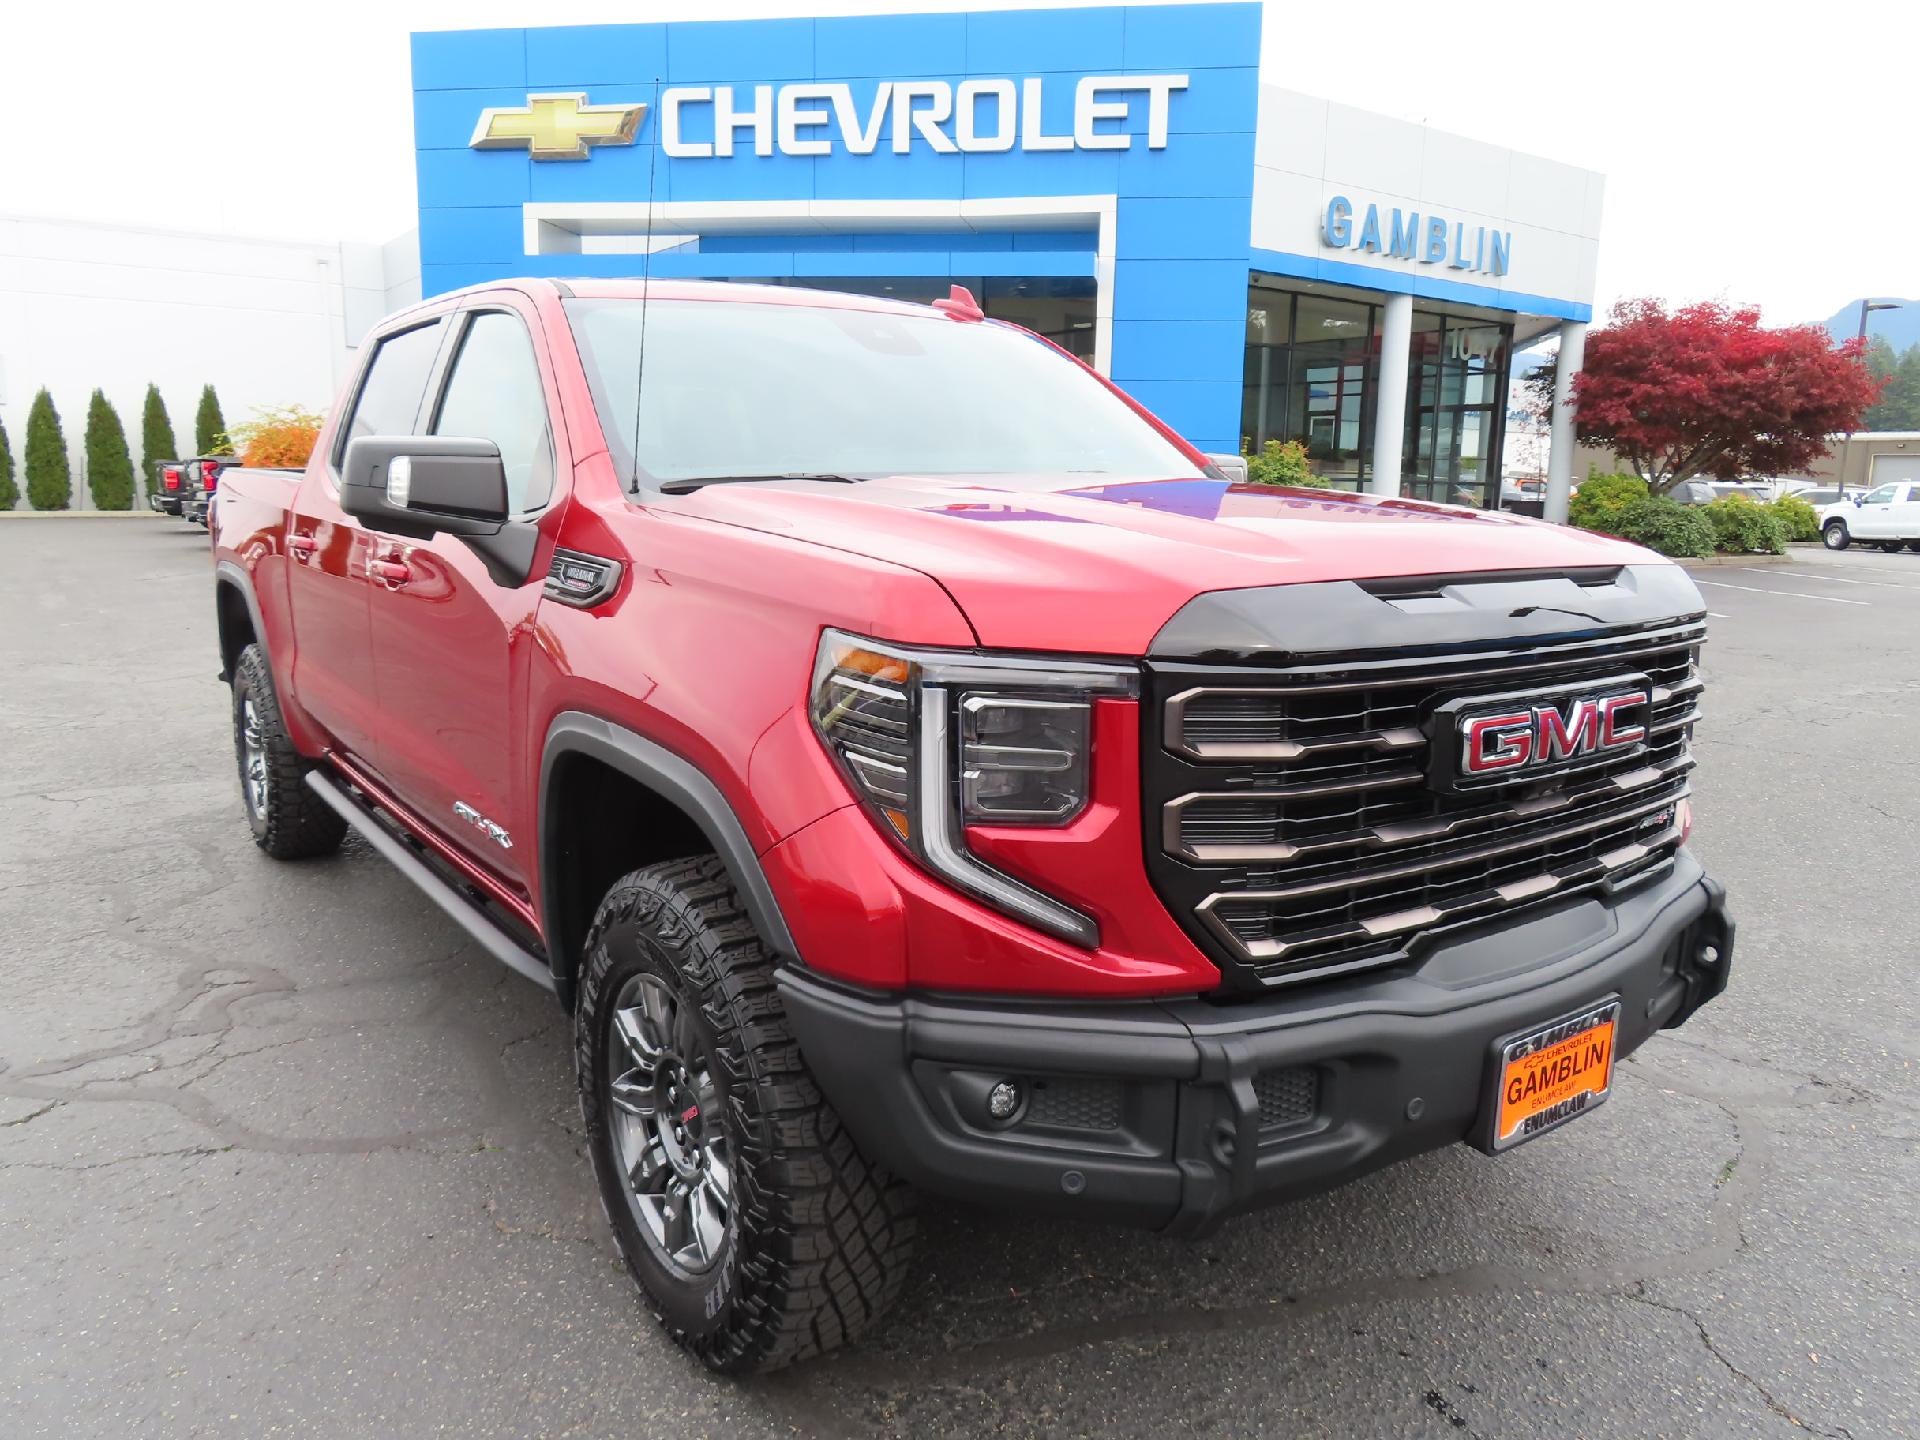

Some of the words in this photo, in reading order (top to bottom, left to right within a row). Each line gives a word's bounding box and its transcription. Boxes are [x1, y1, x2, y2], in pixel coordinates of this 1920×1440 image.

[660, 74, 1189, 158] CHEVROLET
[1322, 196, 1512, 277] GAMBLIN
[1461, 691, 1648, 776] GMC
[1507, 1040, 1605, 1105] GAMBLIN
[1546, 1033, 1593, 1060] CHEVROLET
[1524, 1090, 1589, 1135] ENUMCLAW
